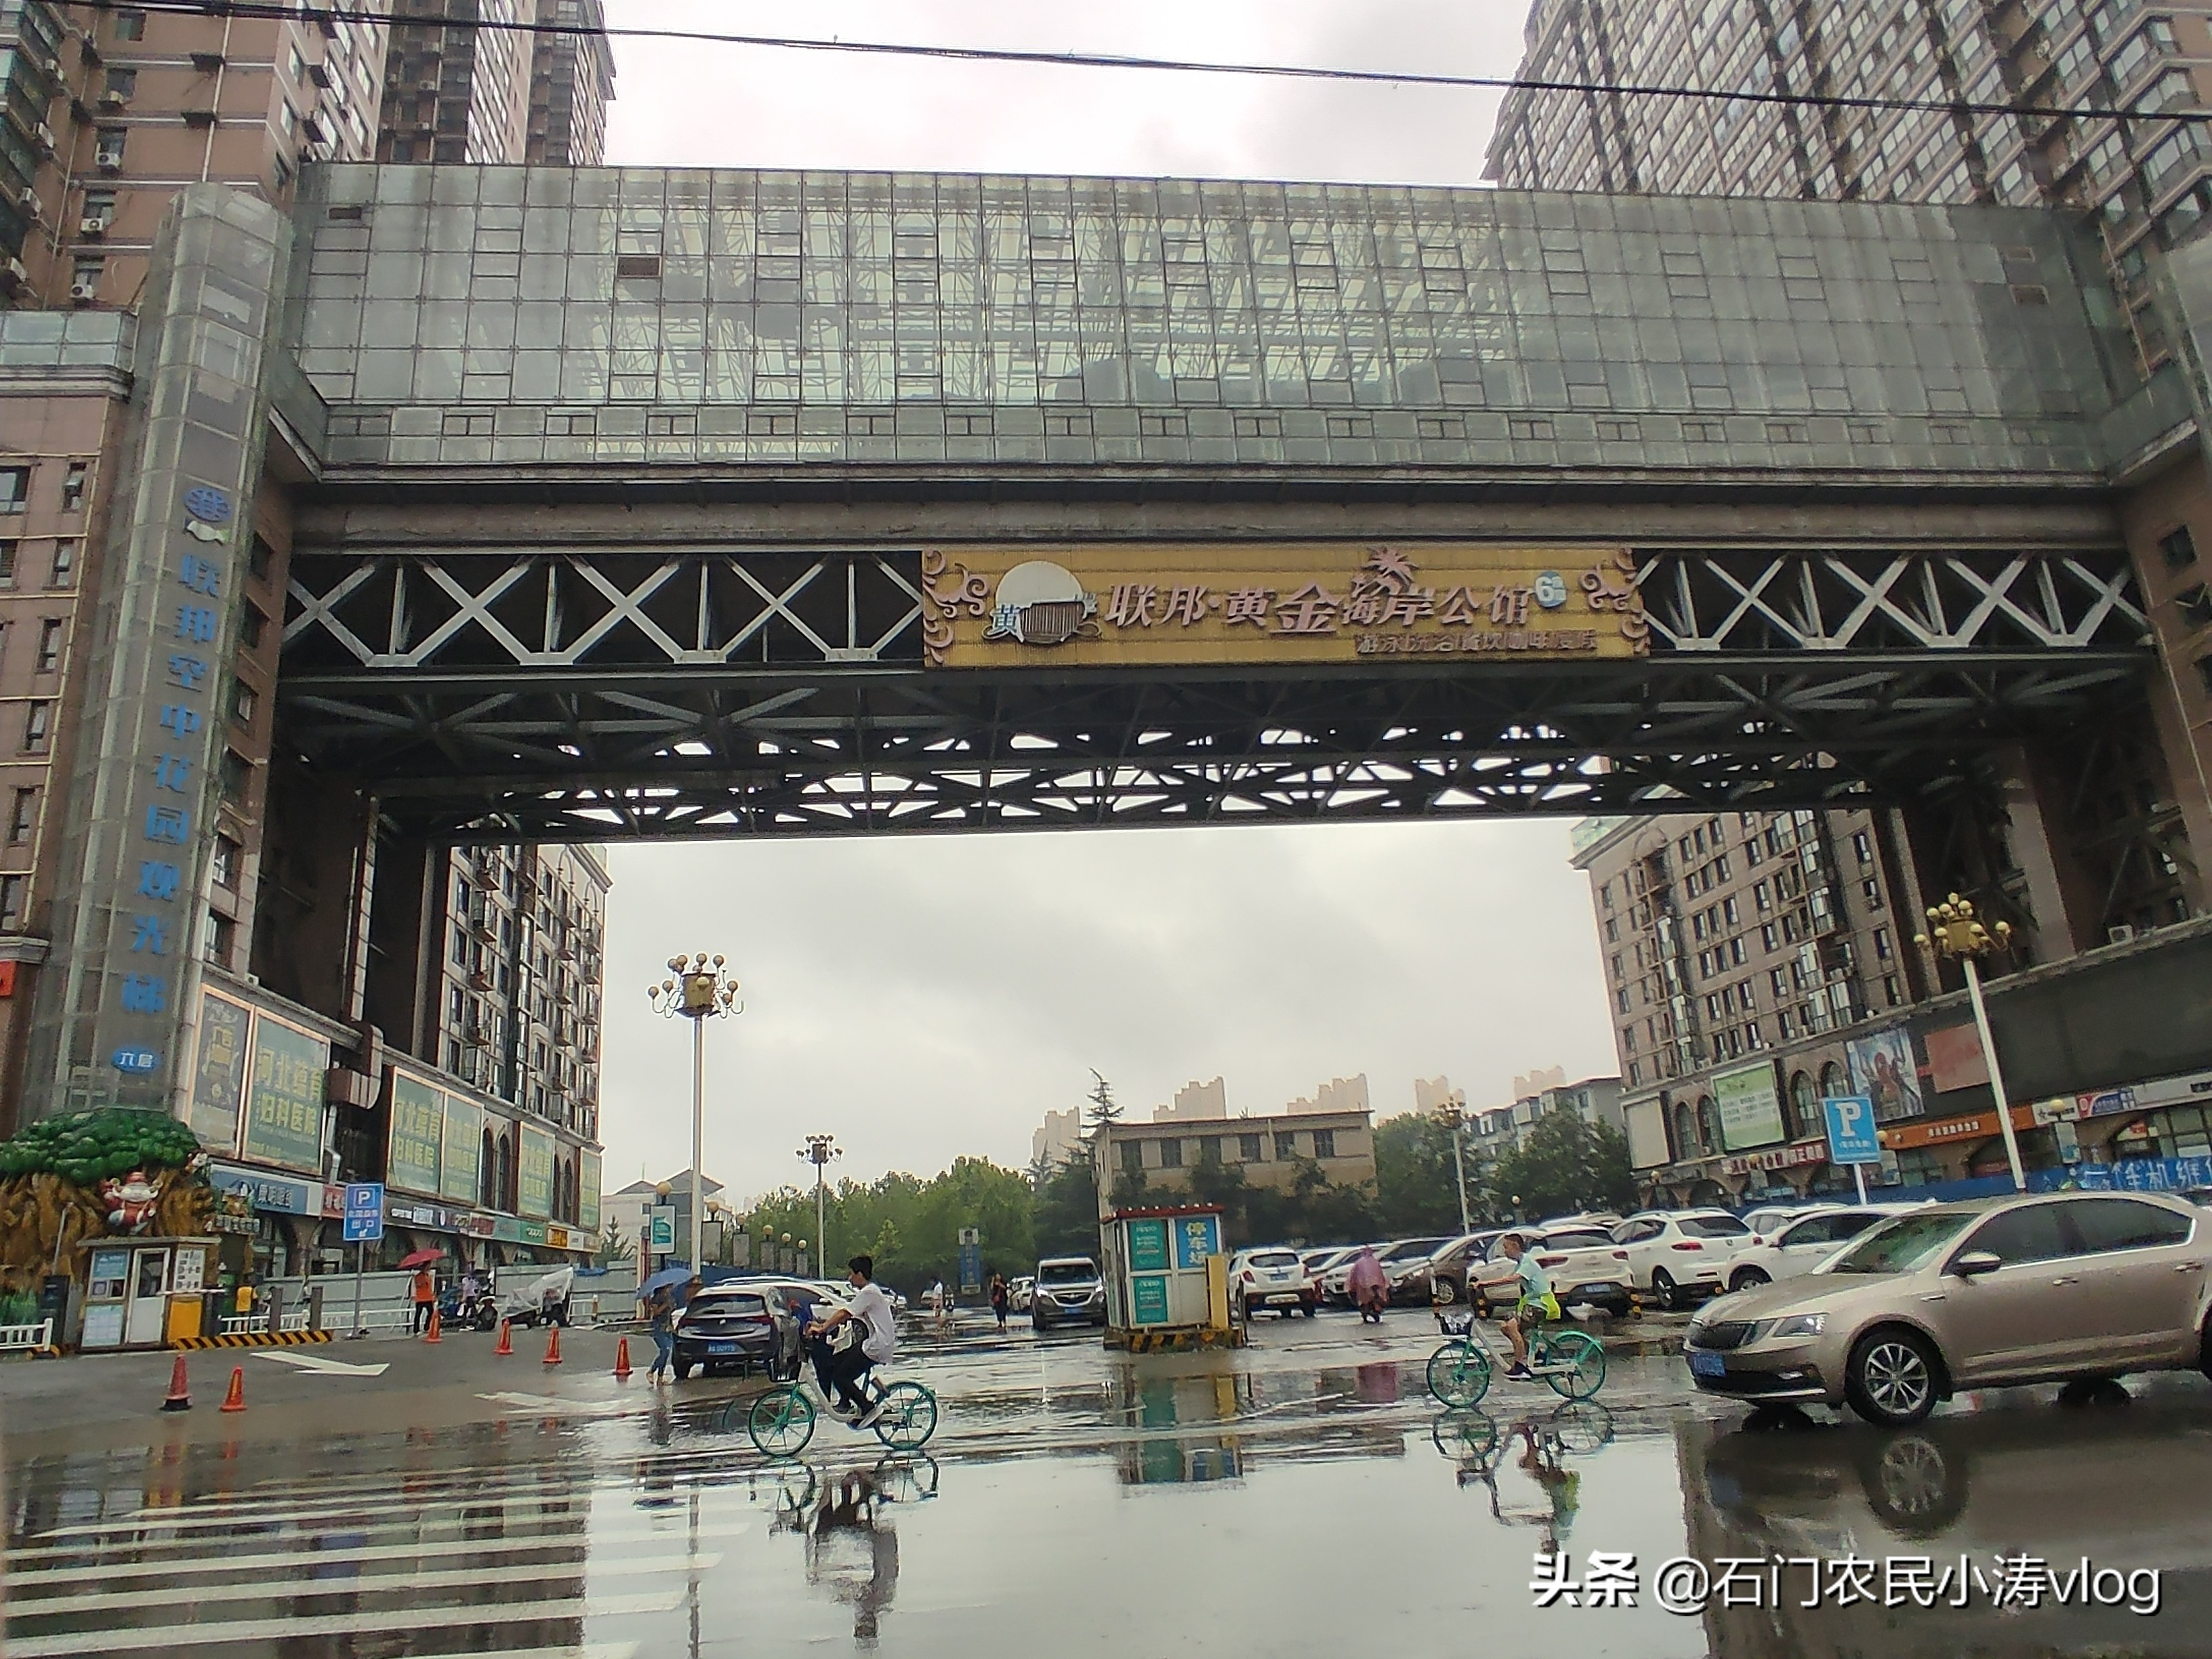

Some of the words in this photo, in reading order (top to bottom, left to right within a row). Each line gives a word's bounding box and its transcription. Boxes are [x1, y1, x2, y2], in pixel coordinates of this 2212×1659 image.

[120, 1052, 153, 1067] 六层
[1836, 1102, 1861, 1137] P
[358, 1191, 371, 1205] P
